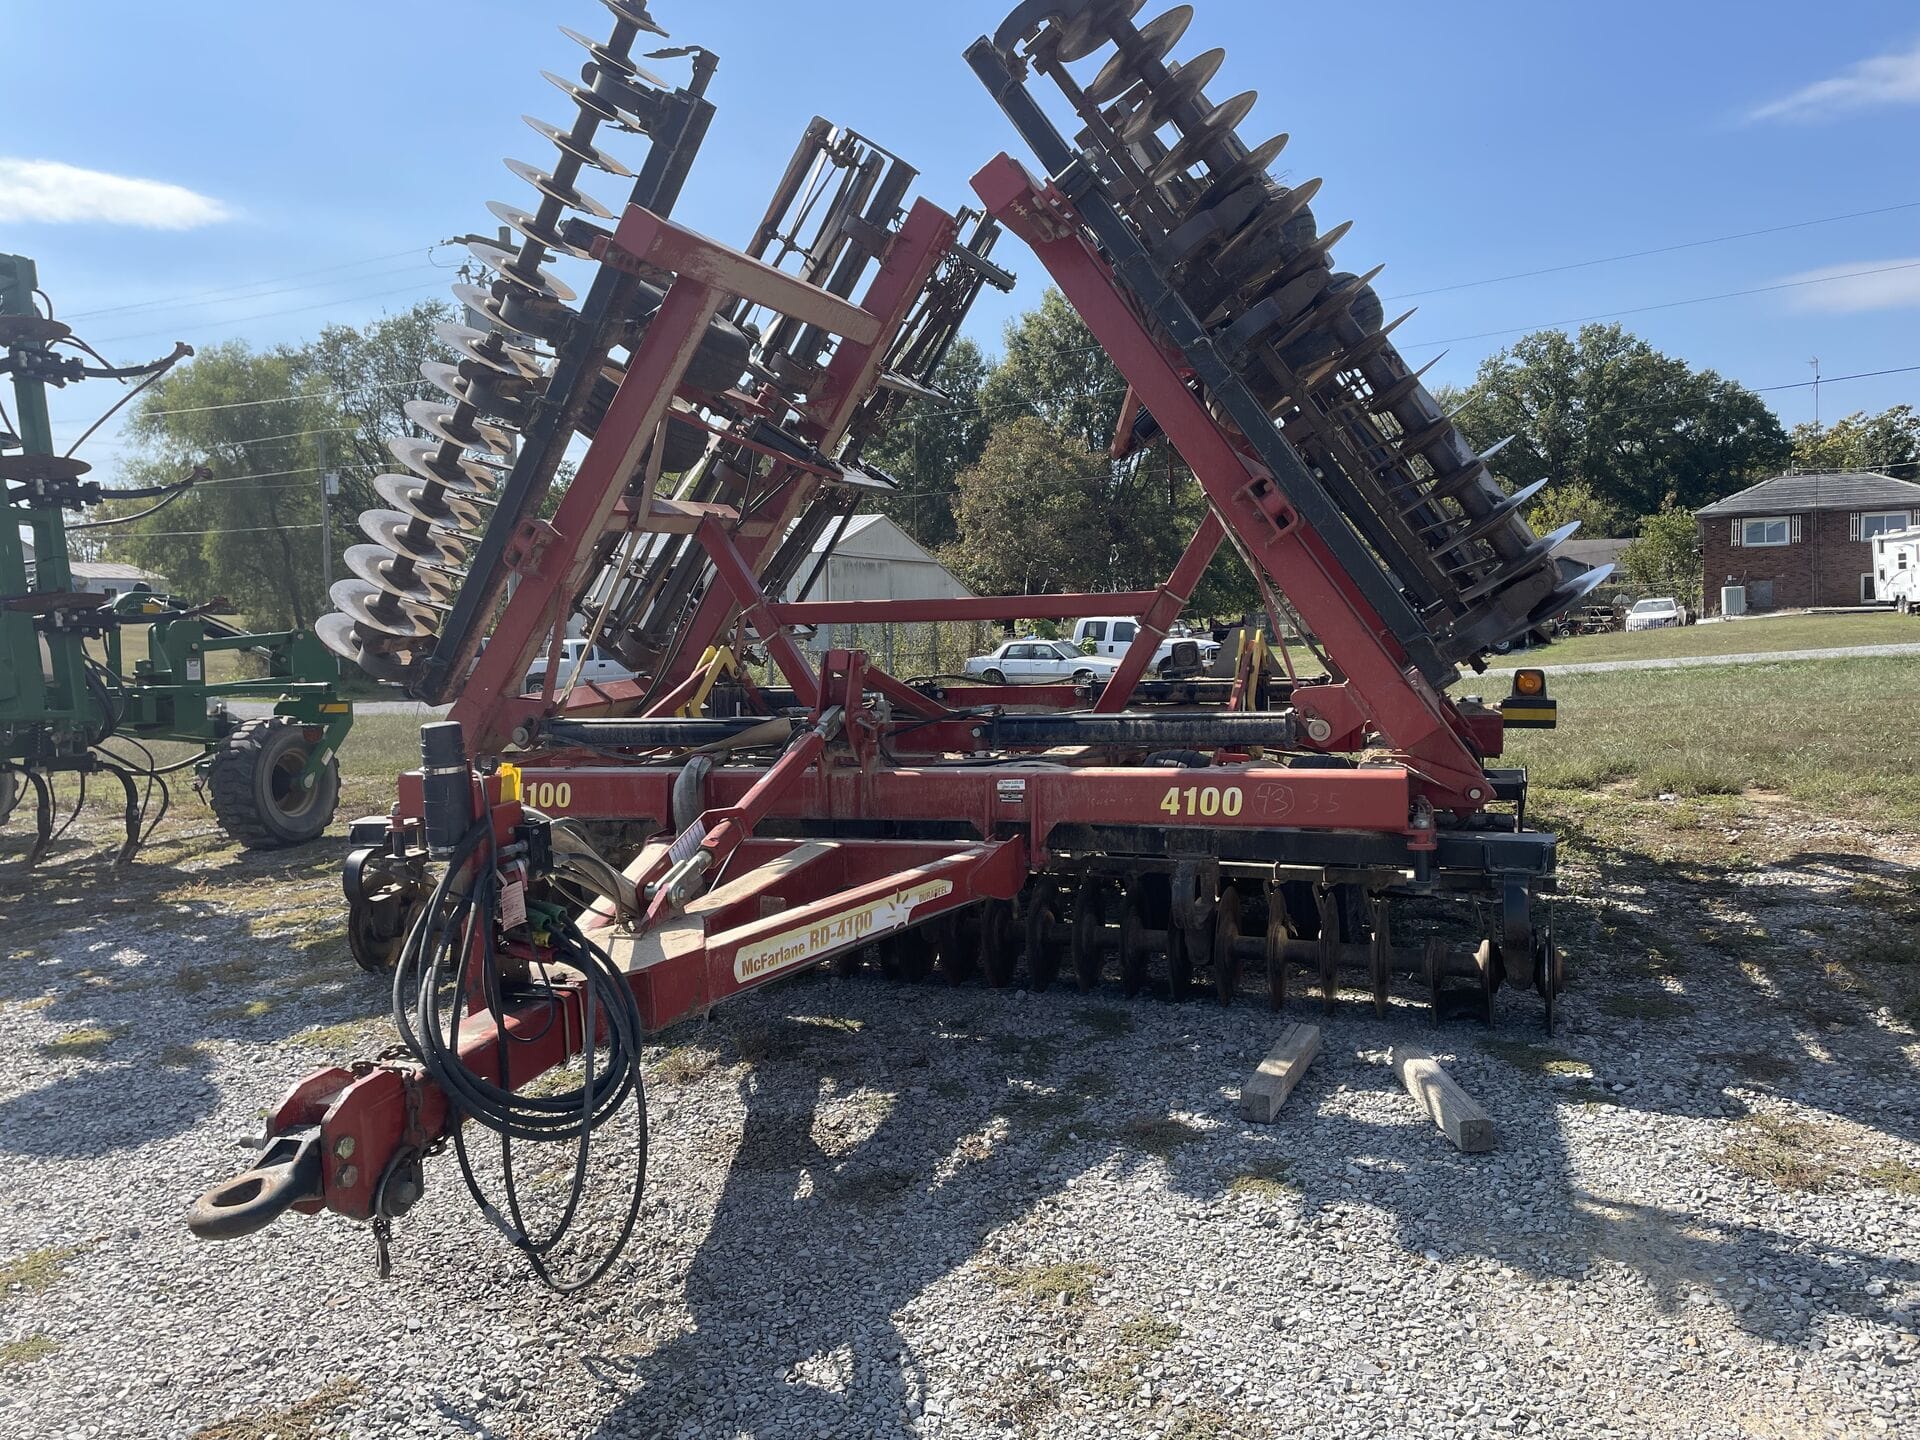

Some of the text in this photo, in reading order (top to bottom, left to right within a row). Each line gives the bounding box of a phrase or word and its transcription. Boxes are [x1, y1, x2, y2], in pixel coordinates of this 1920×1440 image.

[1160, 786, 1244, 816] 4100
[741, 942, 805, 977] McFarlane
[809, 910, 873, 952] RD-4100
